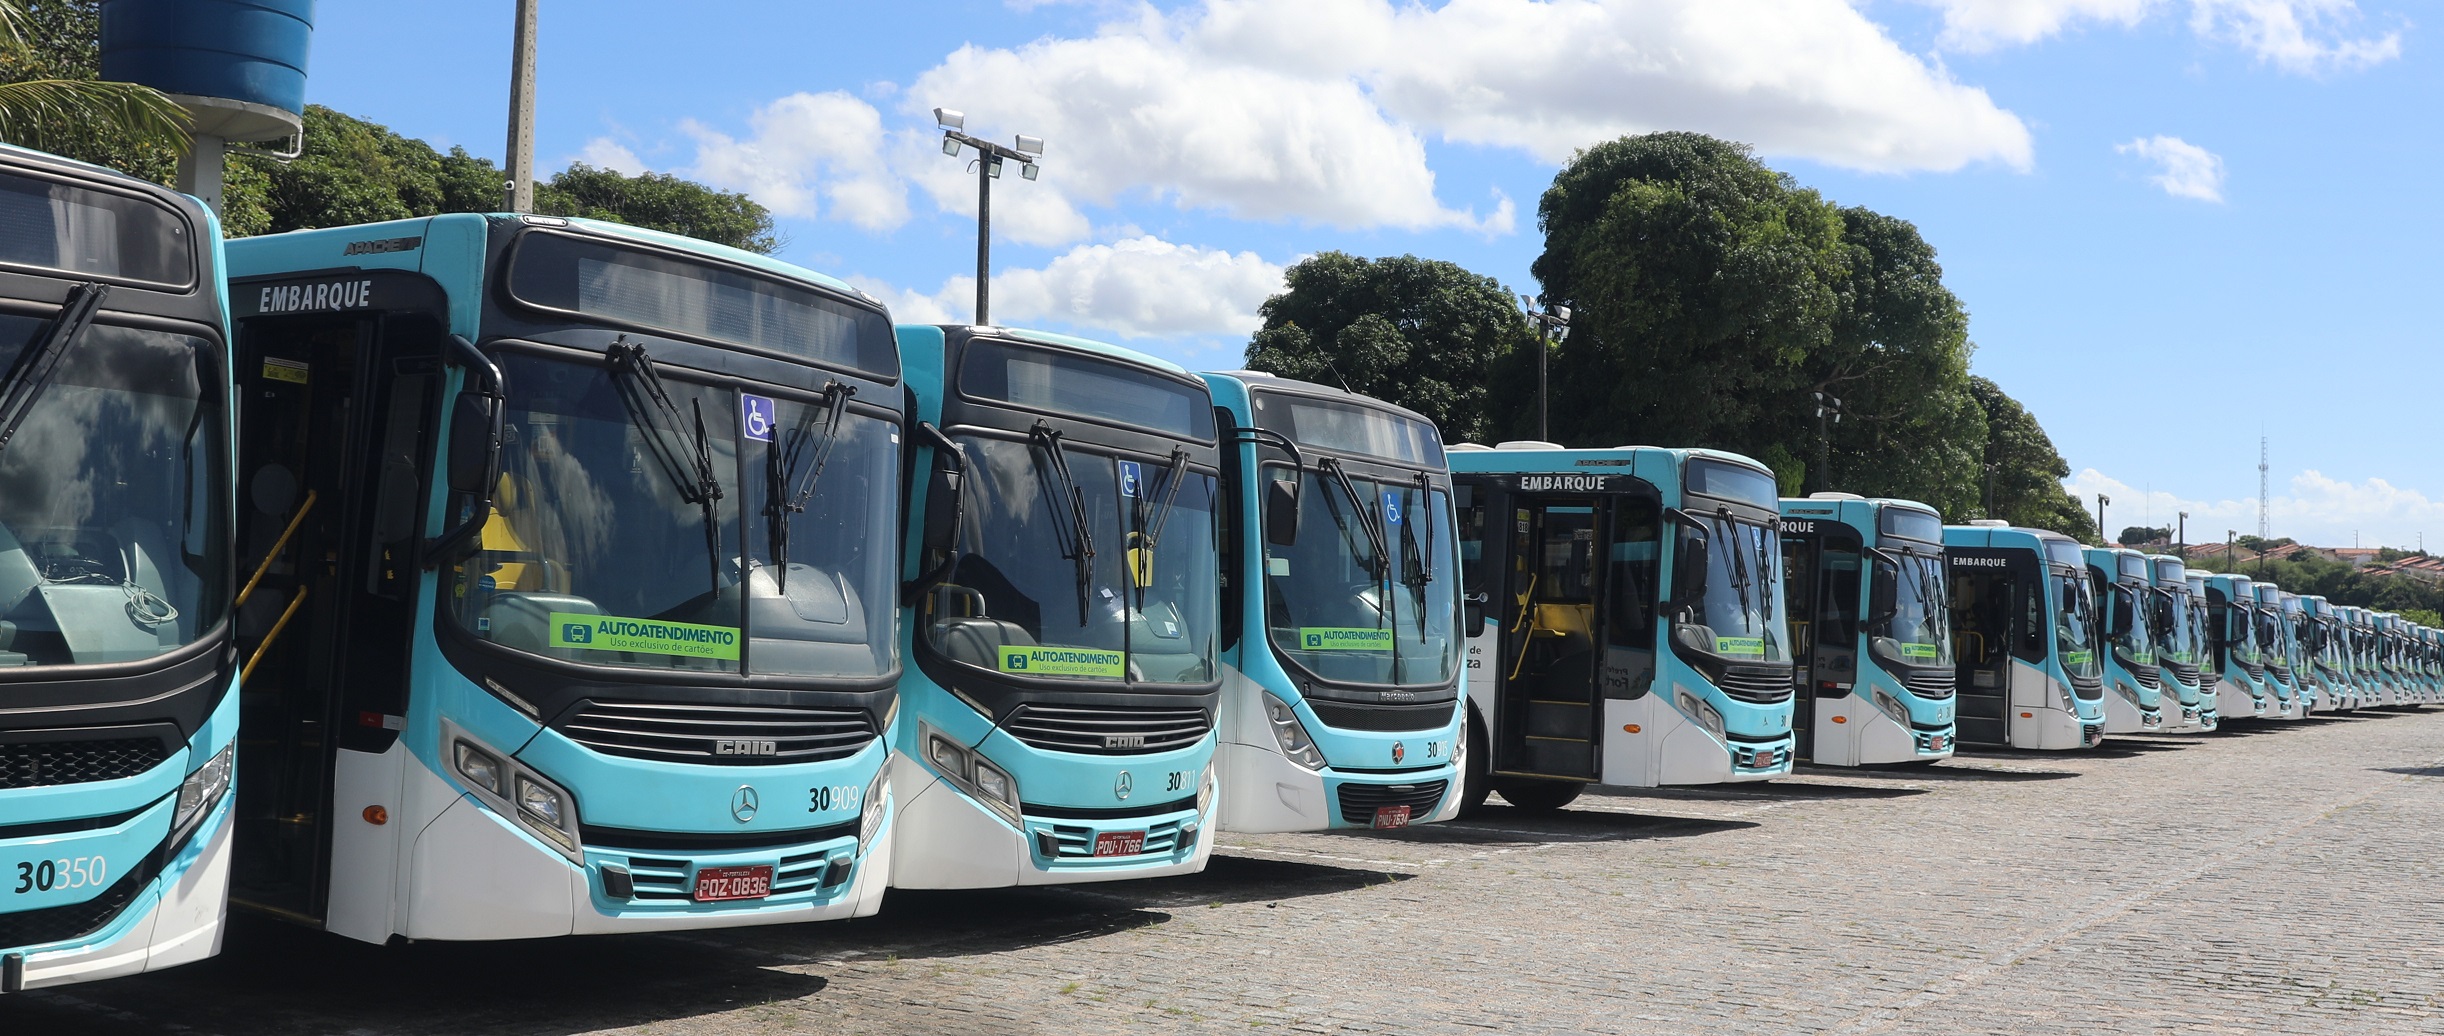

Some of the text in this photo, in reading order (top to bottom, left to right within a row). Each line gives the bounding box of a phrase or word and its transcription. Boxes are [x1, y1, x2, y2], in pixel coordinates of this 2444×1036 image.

[259, 280, 371, 312] EMBARQUE
[1521, 476, 1605, 491] EMBARQUE
[1779, 521, 1814, 533] RQUE
[1953, 557, 2006, 568] EMBARQUE
[597, 620, 734, 646] AUTOATENDIMENTO
[1324, 631, 1390, 641] AUTOATENDIMENTO
[610, 637, 714, 654] Uso exclusivo de cartões
[1469, 646, 1482, 654] de
[1031, 650, 1120, 665] AUTOATENDIMENTO
[1052, 664, 1079, 672] exclusivo
[715, 740, 776, 756] CAIO
[1105, 736, 1145, 748] CAIO
[1166, 769, 1196, 792] 30811
[808, 785, 859, 813] 30909
[1096, 839, 1142, 855] POU-1766
[14, 855, 106, 894] 30350
[699, 876, 768, 897] POZ-0836
